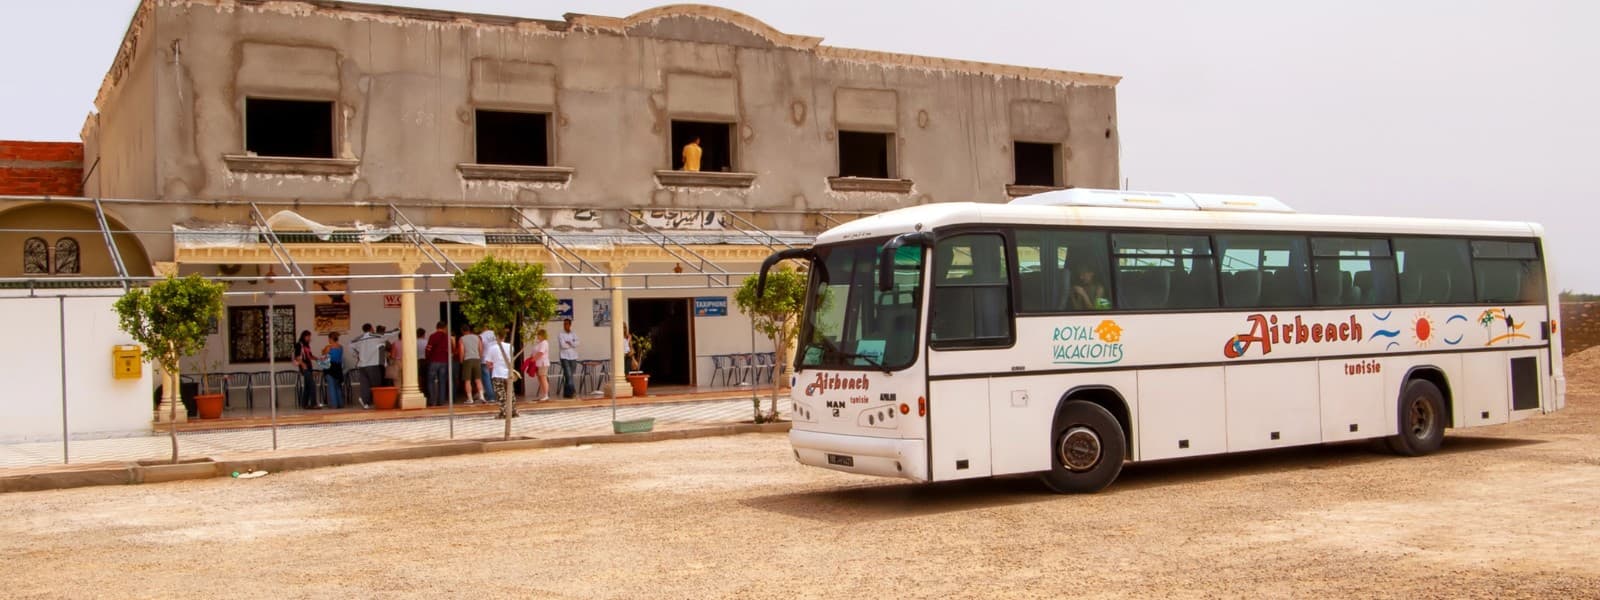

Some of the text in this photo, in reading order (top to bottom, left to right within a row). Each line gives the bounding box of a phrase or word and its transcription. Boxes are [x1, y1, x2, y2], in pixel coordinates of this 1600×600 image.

[696, 300, 727, 308] TAXIPHONE
[1053, 326, 1094, 341] ROYAL
[1224, 313, 1363, 359] Airbeach
[1053, 343, 1123, 362] VACACIONES
[1344, 360, 1381, 375] tunisie
[805, 372, 869, 396] Airbeach
[826, 401, 846, 409] MAN
[850, 396, 869, 404] tunisie
